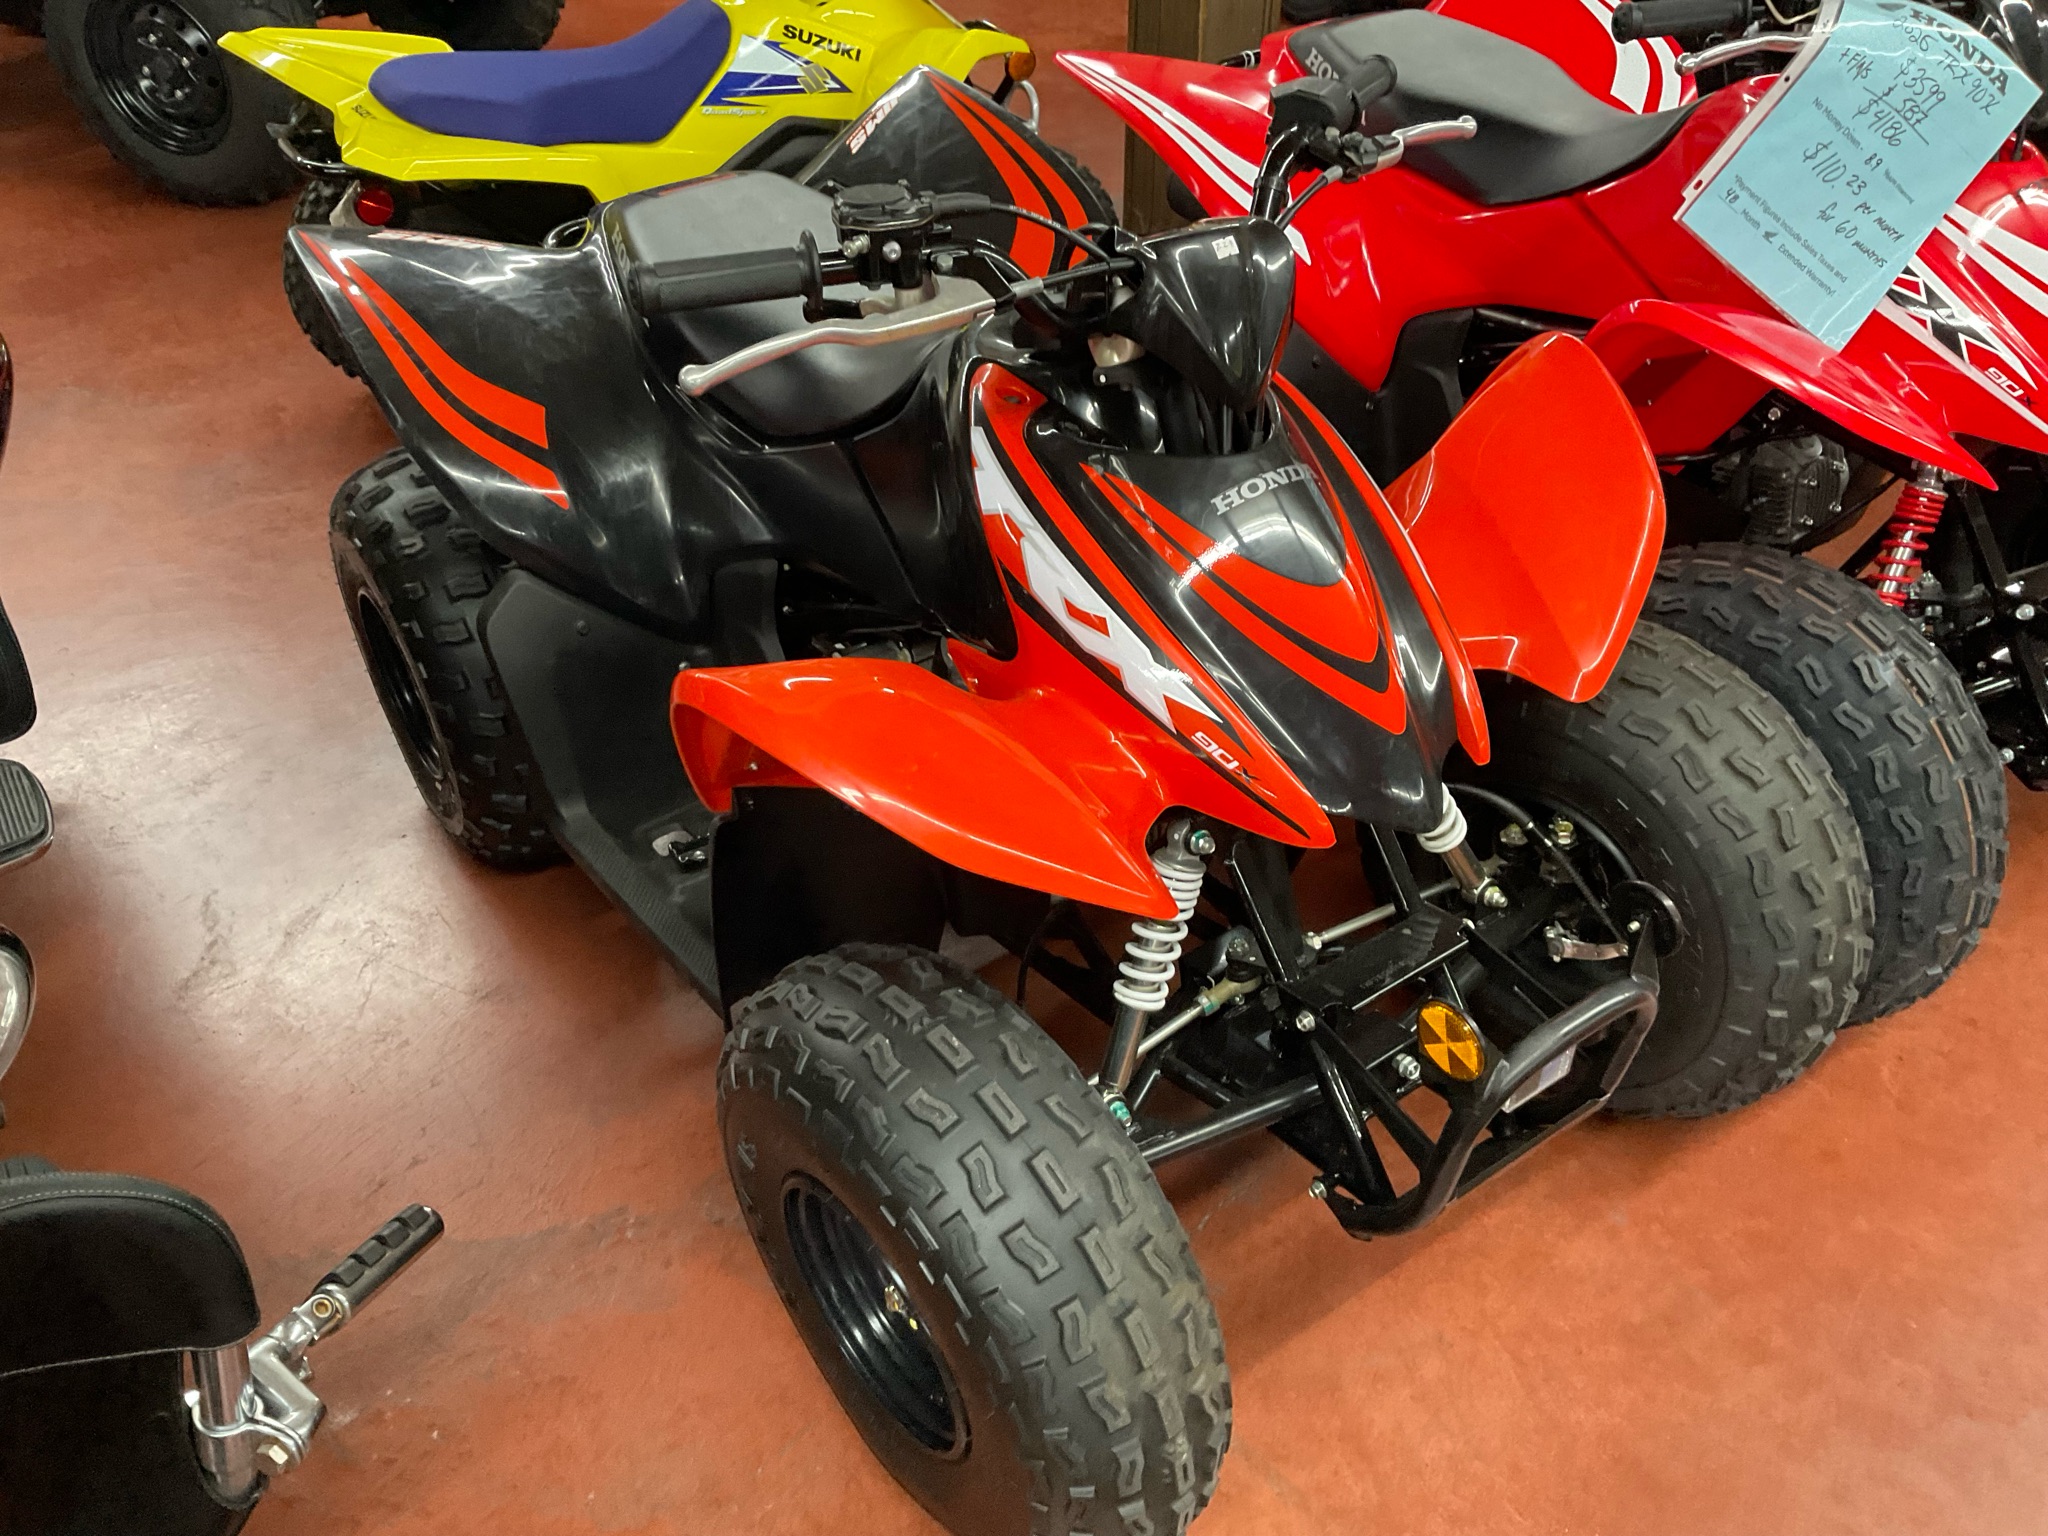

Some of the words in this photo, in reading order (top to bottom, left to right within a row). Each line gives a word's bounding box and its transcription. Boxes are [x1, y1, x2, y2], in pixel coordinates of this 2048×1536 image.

[782, 24, 861, 62] SUZUKI
[1910, 8, 2008, 96] HONDA
[1937, 50, 1973, 86] TRX
[1894, 57, 1946, 113] $3599
[1812, 96, 1824, 111] No
[1822, 106, 1844, 132] Money
[1841, 126, 1861, 150] Down
[1852, 98, 1907, 147] $4186
[1741, 208, 1762, 231] Month
[1778, 243, 1808, 273] Extended
[1805, 266, 1837, 297] Warranty!
[1760, 199, 1782, 225] Figures
[1780, 218, 1803, 243] Include
[1800, 238, 1819, 258] Sales
[1817, 253, 1836, 273] Taxes
[1833, 268, 1848, 284] and
[1835, 220, 1858, 239] 60
